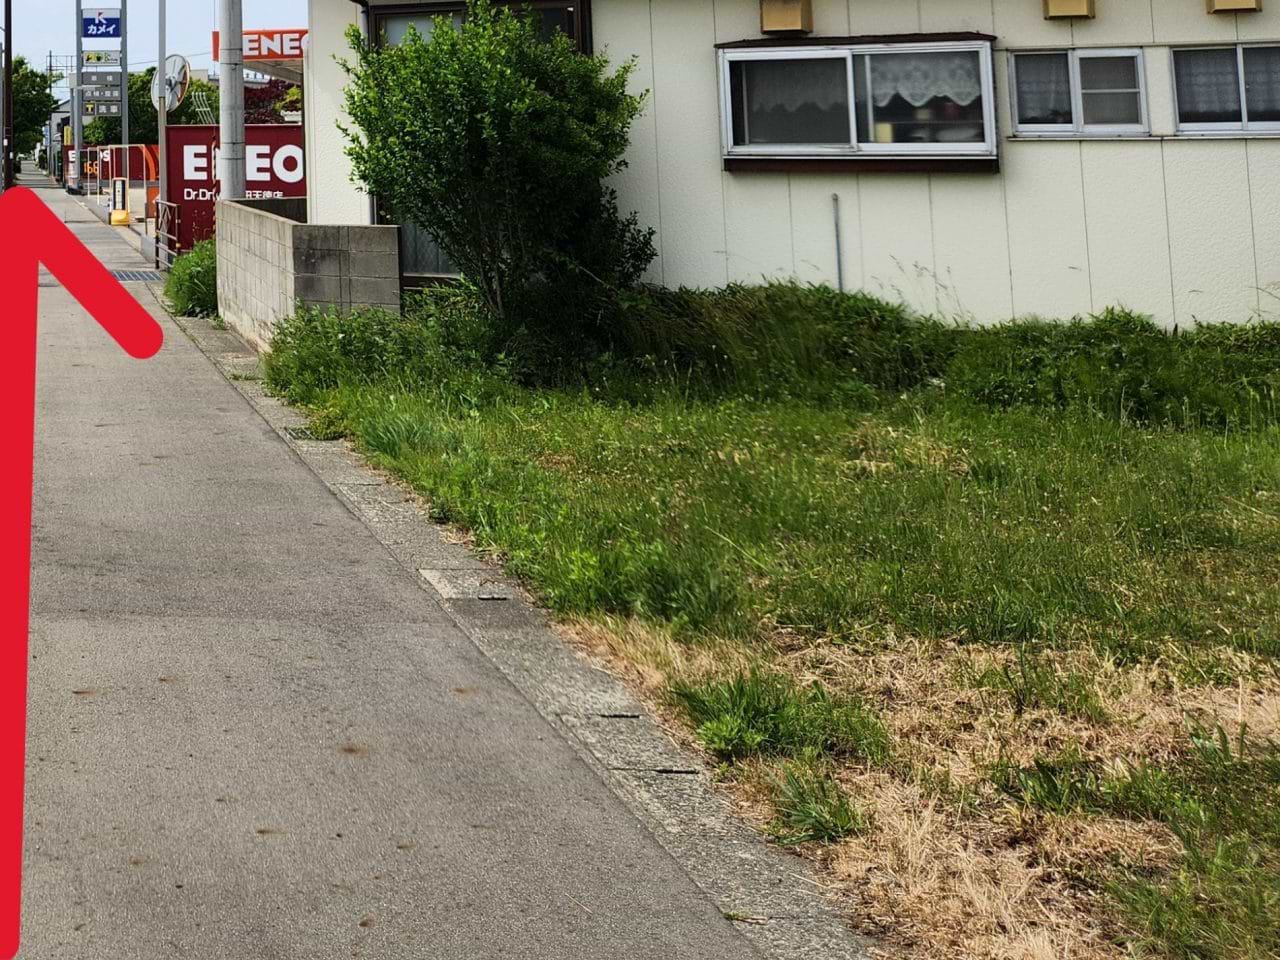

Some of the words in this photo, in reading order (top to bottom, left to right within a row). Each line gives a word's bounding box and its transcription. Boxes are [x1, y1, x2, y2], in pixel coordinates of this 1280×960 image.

[87, 24, 116, 35] カメイ
[243, 32, 308, 56] ENE
[183, 144, 304, 183] EEO
